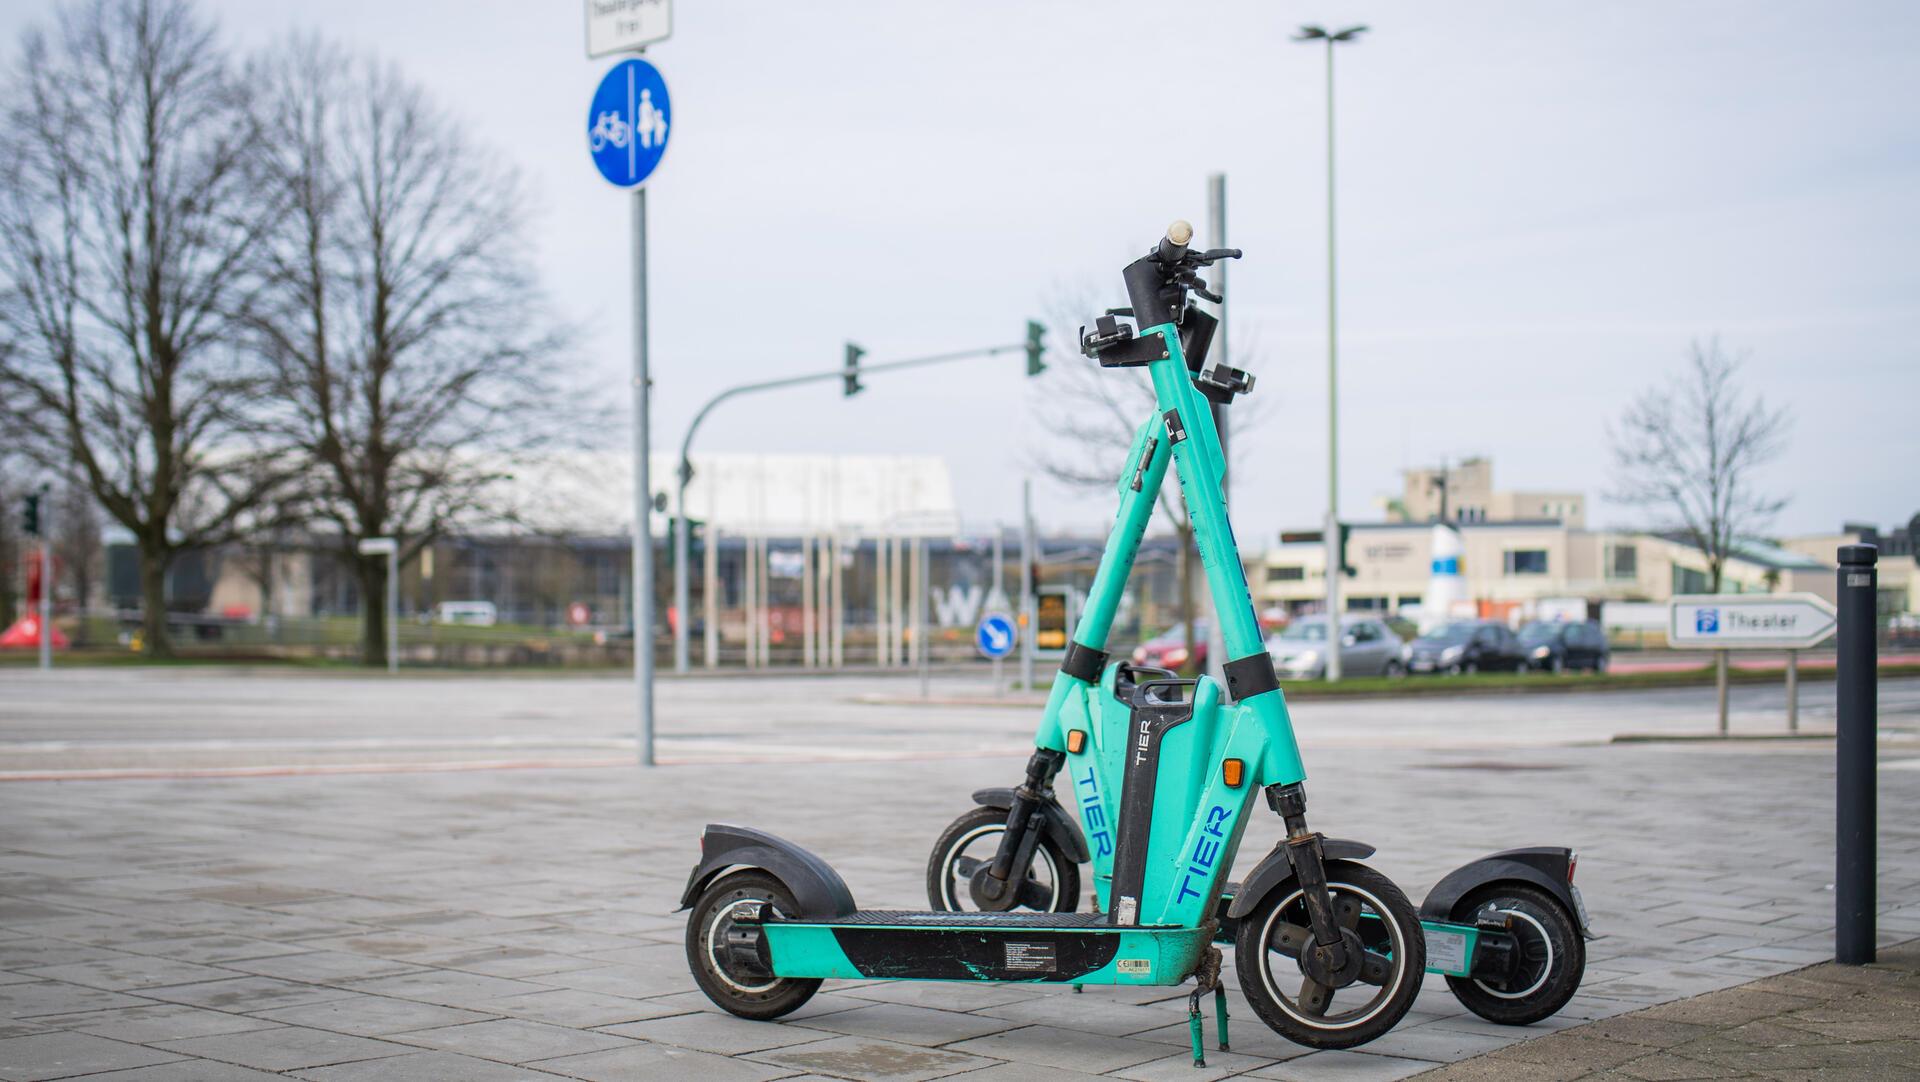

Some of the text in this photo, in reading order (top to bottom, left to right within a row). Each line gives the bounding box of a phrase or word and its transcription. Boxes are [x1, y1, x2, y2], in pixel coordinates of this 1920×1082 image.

[1727, 612, 1798, 629] Theater
[1135, 719, 1152, 767] TIER
[1079, 767, 1112, 859] TIER
[1176, 805, 1233, 905] TIER
